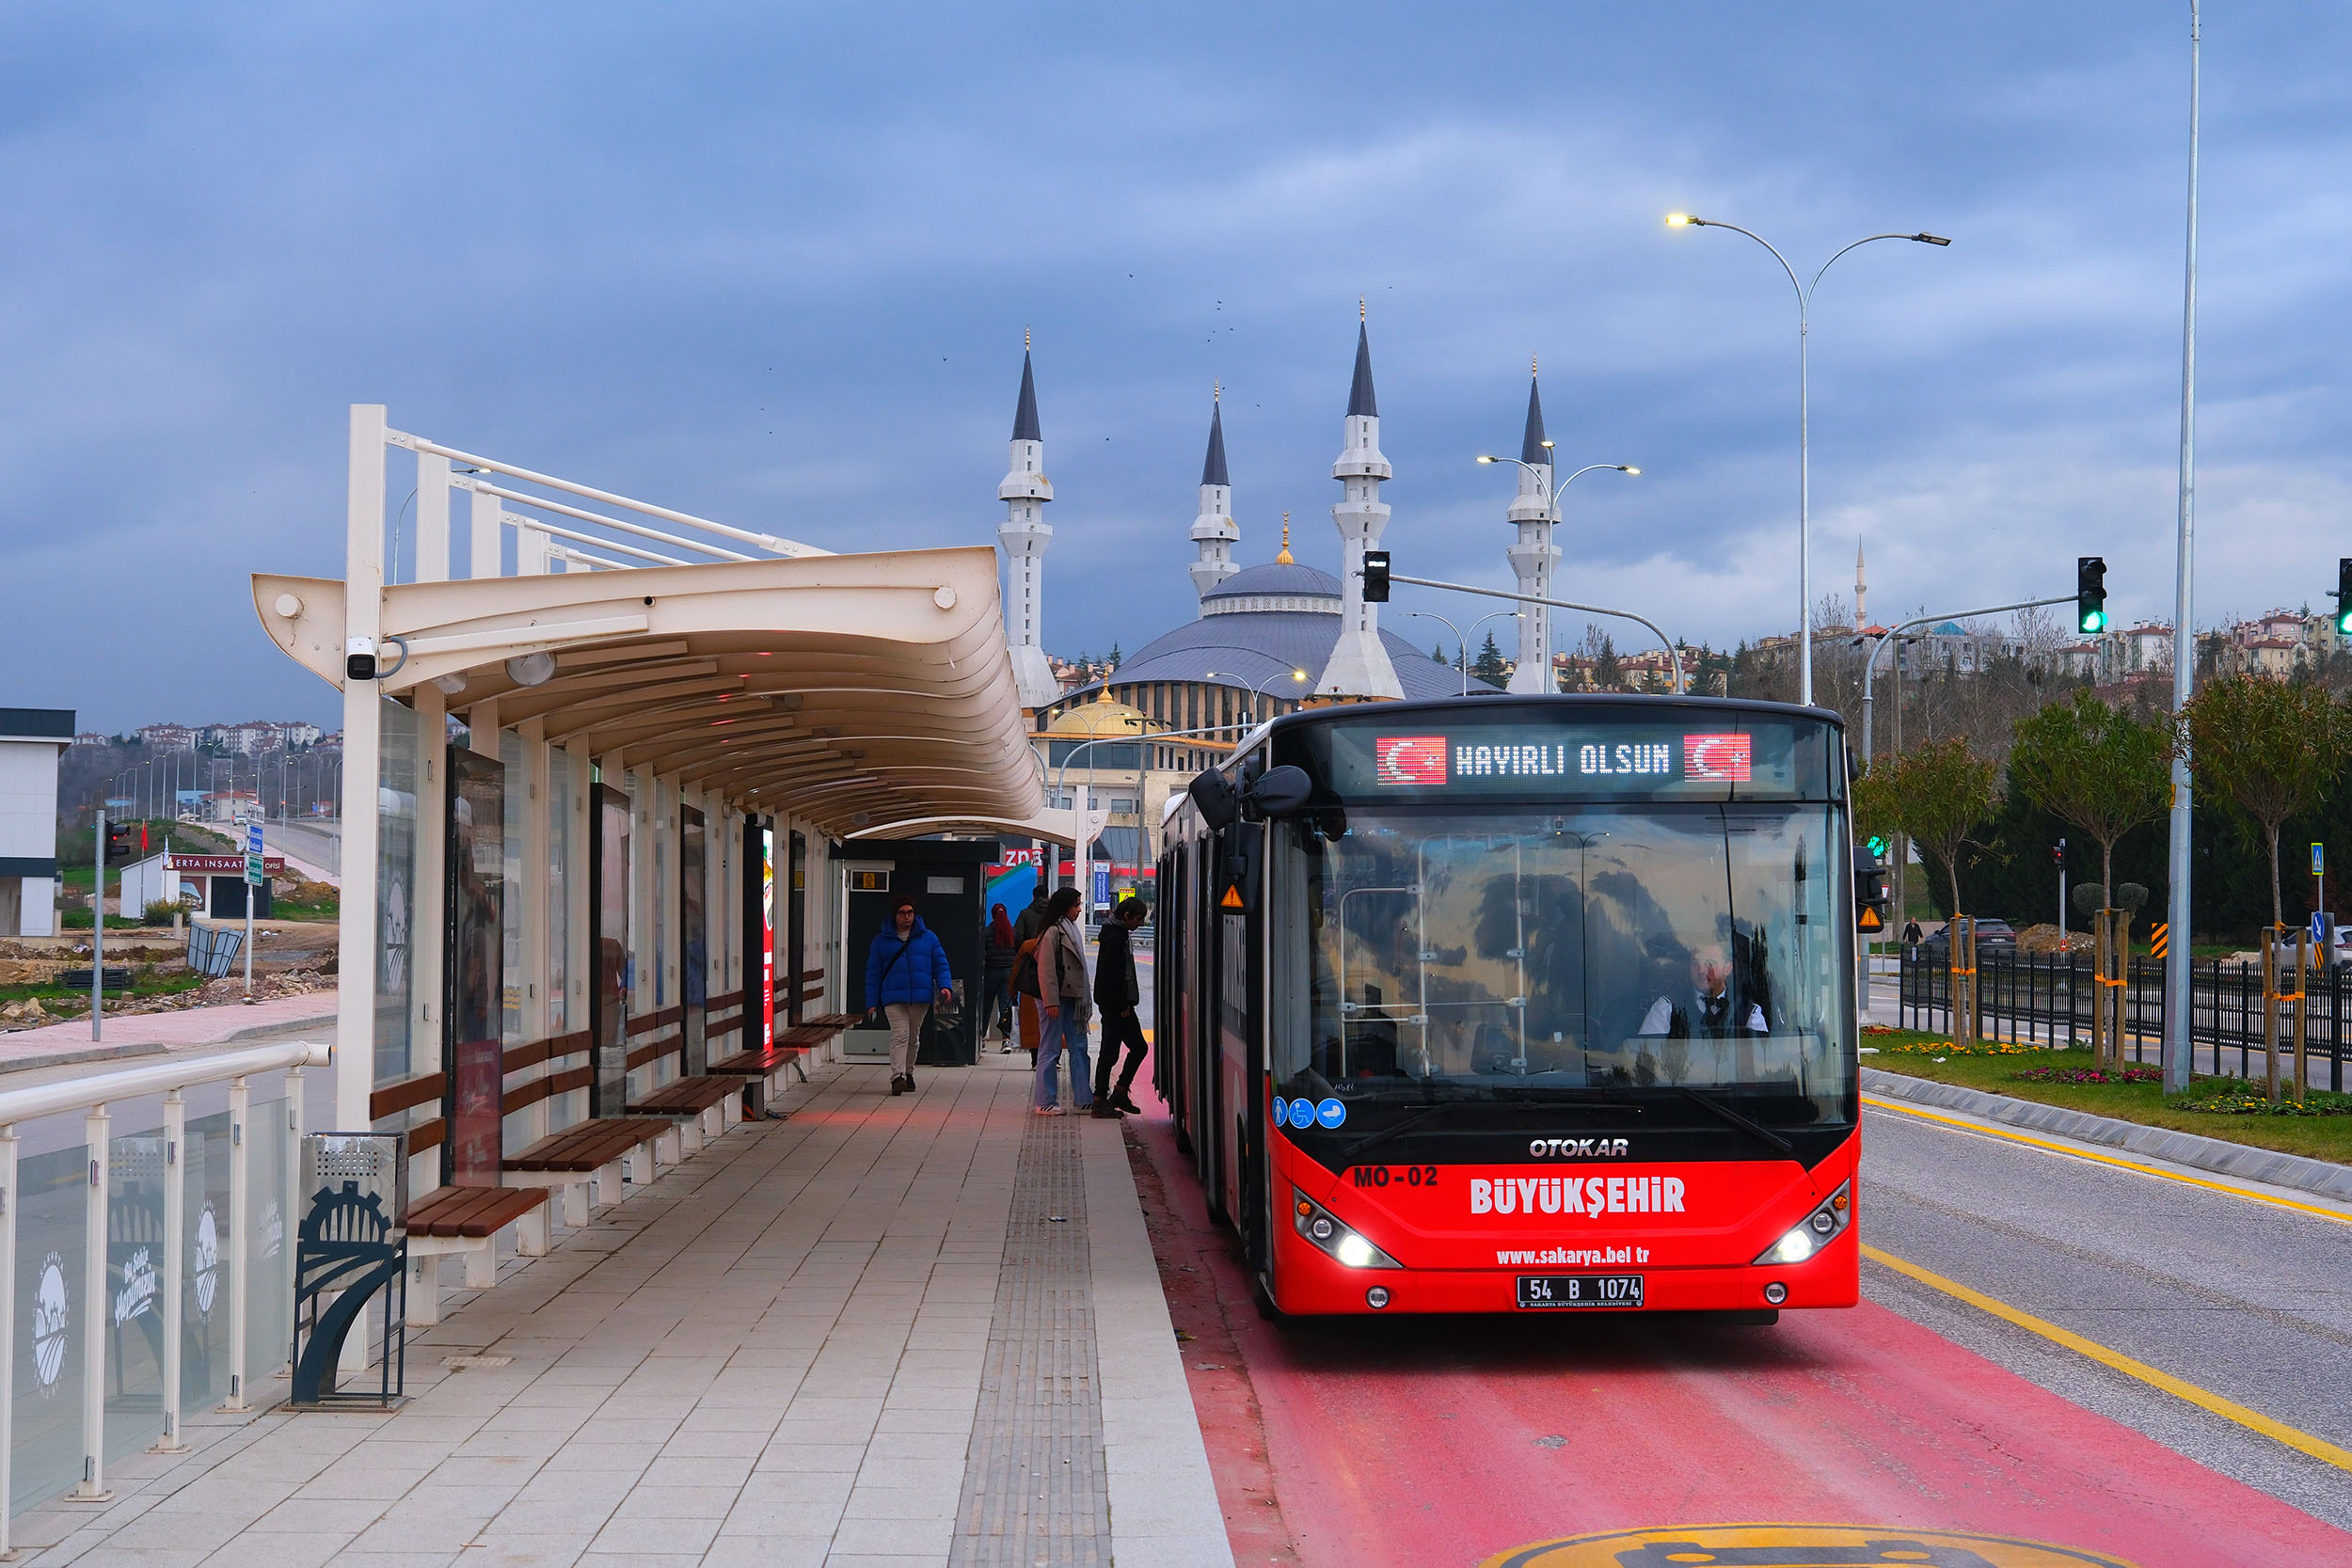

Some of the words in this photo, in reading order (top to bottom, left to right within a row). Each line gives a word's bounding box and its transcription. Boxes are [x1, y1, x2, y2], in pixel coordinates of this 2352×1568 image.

[1456, 745, 1565, 775] HAYIRLI
[1581, 744, 1669, 774] OLSUN
[176, 859, 201, 867] ERTA
[1529, 1138, 1629, 1157] OTOKAR
[1470, 1177, 1685, 1219] BÜYÜKŞEHİR
[1497, 1246, 1631, 1267] www.sakarya.bel
[1636, 1246, 1649, 1262] tr
[1530, 1279, 1552, 1300] 54
[1568, 1279, 1580, 1299] B
[1597, 1278, 1640, 1299] 1074
